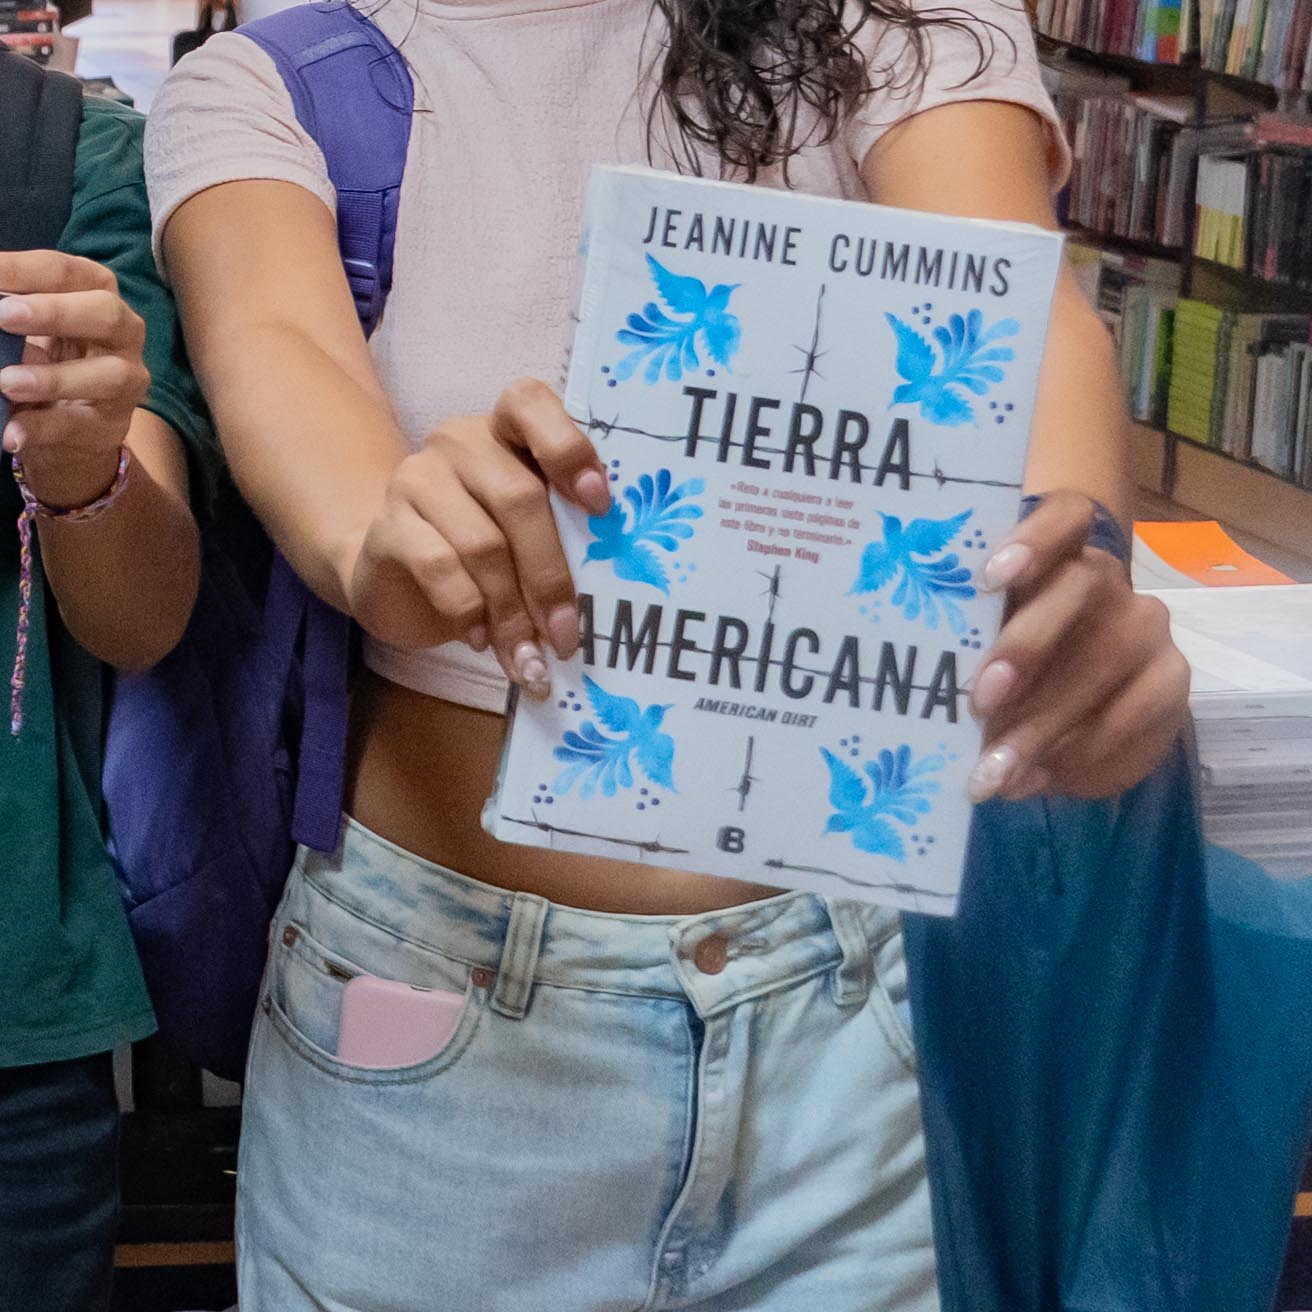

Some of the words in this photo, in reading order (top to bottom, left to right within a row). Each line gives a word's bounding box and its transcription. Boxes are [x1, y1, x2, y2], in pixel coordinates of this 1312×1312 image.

[642, 206, 803, 268] JEANINE
[827, 232, 1014, 298] CUMMINS
[682, 385, 915, 492] TIERRA
[746, 538, 792, 557] Stephen
[794, 546, 820, 565] King
[573, 593, 966, 725] AMERICANA
[693, 697, 779, 723] AMERICAN
[781, 711, 819, 729] DIRT
